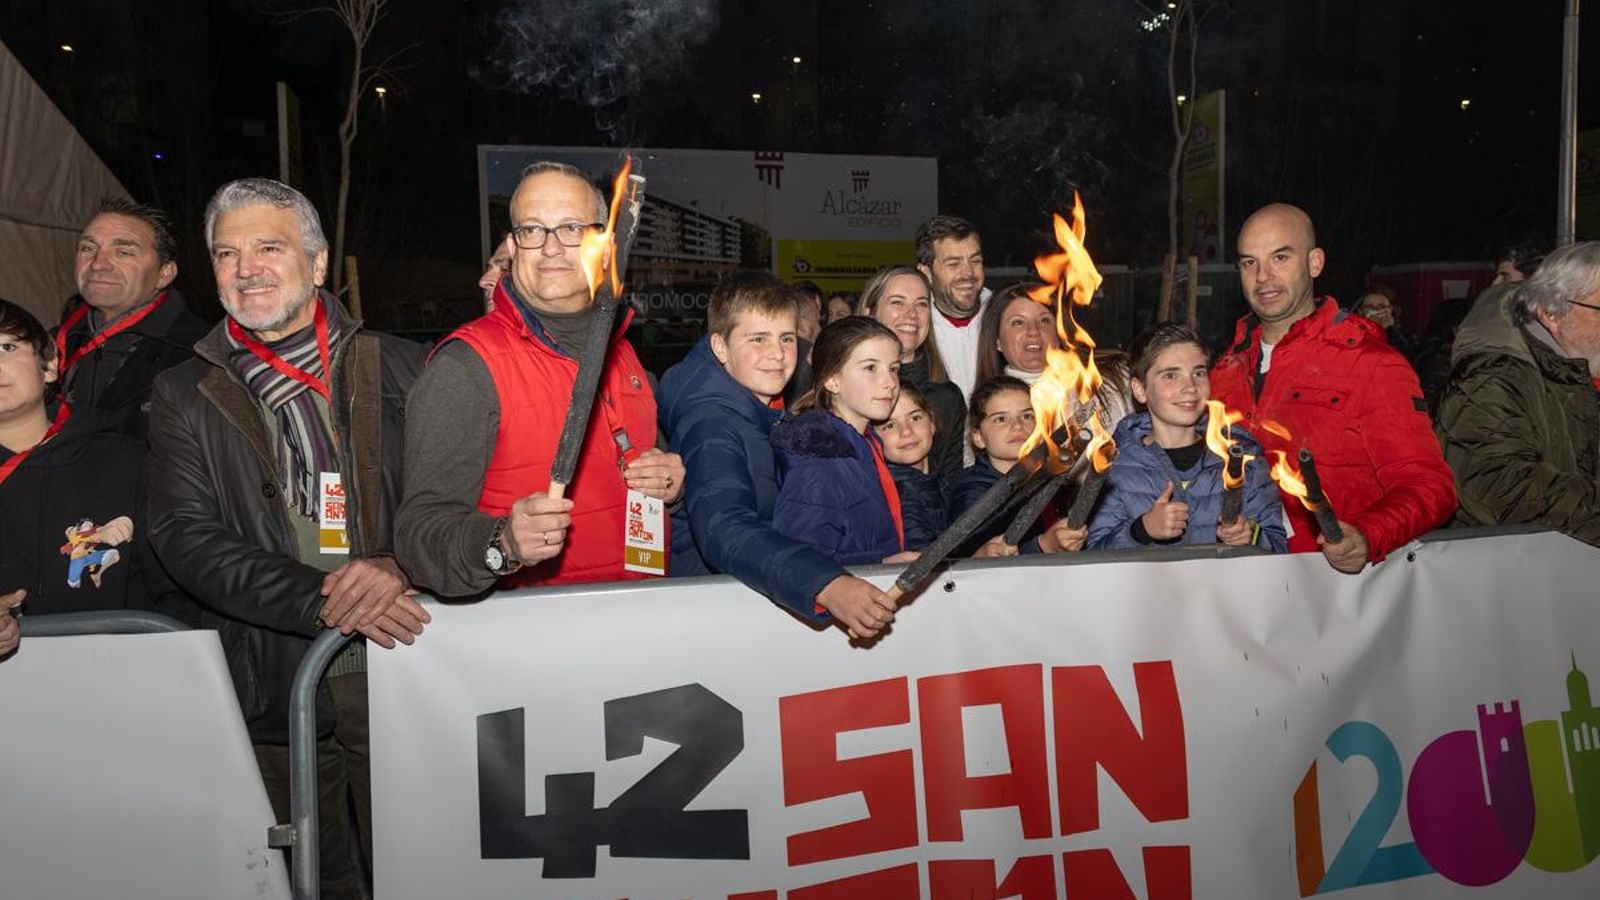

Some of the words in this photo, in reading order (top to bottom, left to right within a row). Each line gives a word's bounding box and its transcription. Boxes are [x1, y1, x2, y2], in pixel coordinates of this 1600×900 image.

[819, 189, 902, 215] Alcázar
[325, 484, 345, 496] 42
[629, 502, 642, 515] 42
[629, 519, 643, 530] SAN
[639, 551, 651, 564] VIP
[476, 682, 750, 879] 42
[778, 660, 1190, 867] SAN
